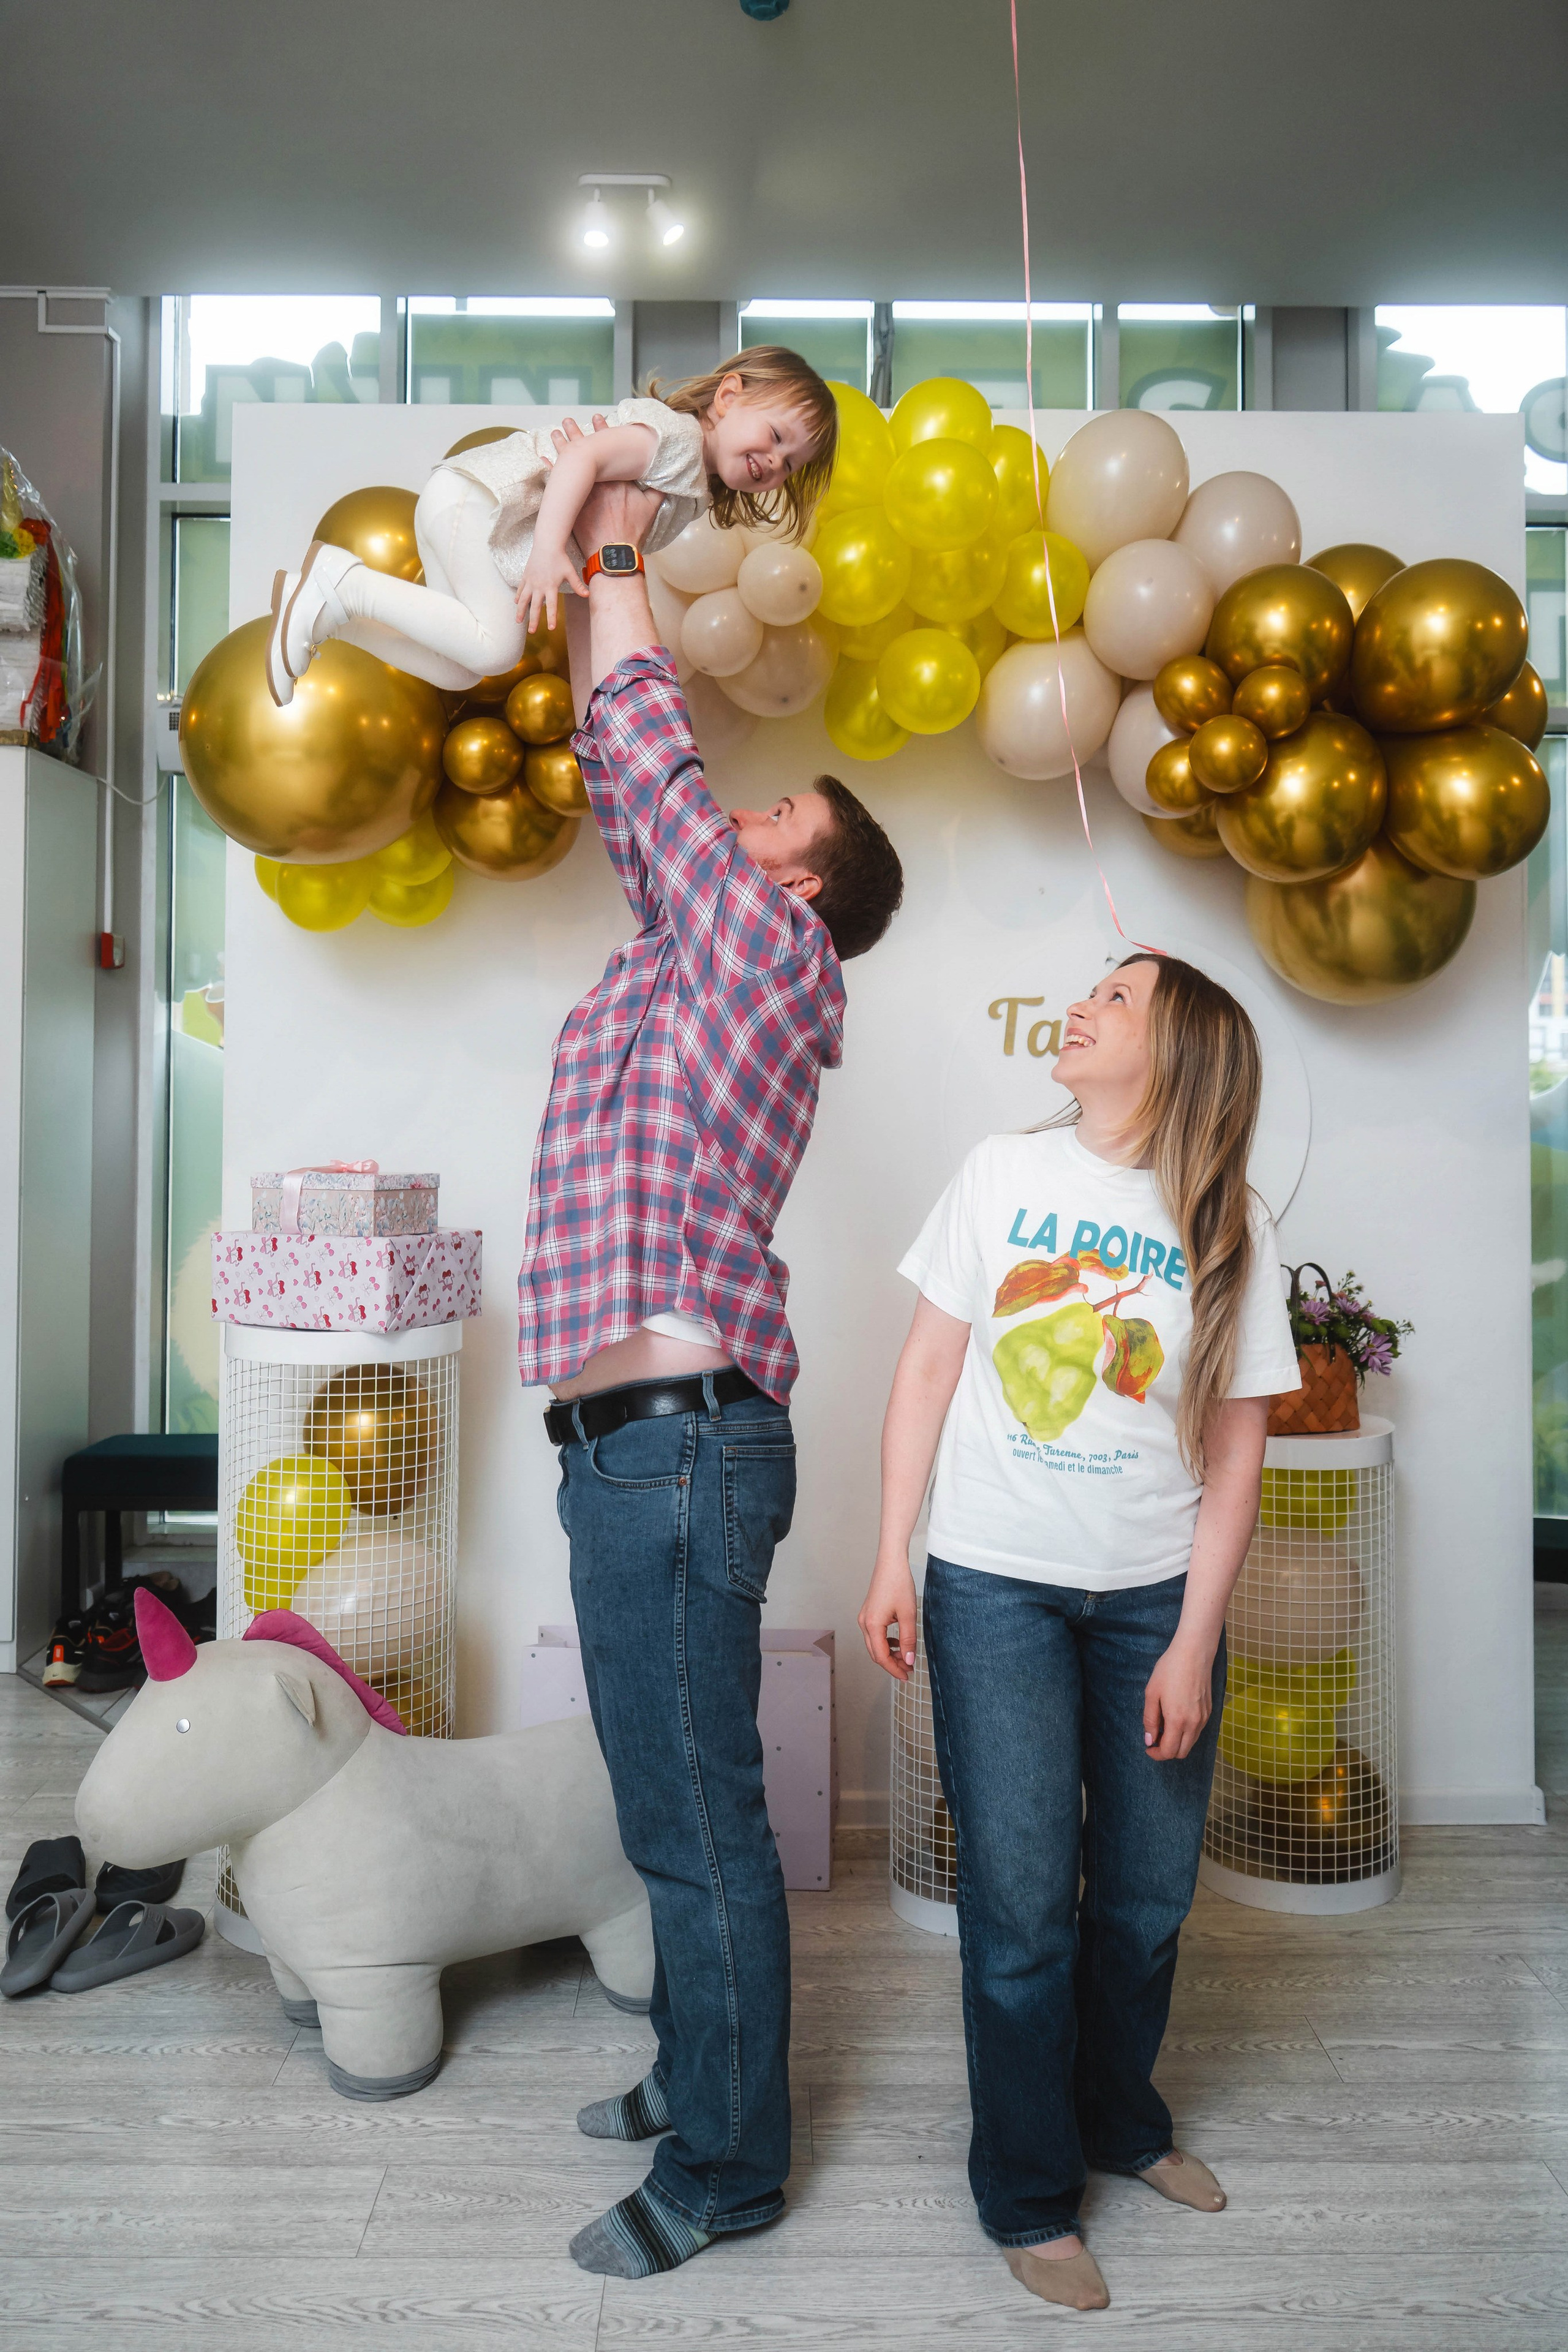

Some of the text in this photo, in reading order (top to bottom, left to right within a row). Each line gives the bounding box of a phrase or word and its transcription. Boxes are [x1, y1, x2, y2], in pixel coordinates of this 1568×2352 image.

[988, 996, 1062, 1058] Ta
[1007, 1208, 1187, 1291] LA POIRE
[1007, 1433, 1018, 1442] 116
[1042, 1444, 1085, 1461] Turenne,
[1089, 1453, 1111, 1463] 7003,
[1114, 1449, 1139, 1461] Paris
[1012, 1448, 1036, 1461] ouvert
[1044, 1460, 1065, 1471] amedi
[1068, 1462, 1076, 1472] et
[1078, 1462, 1085, 1473] le
[1087, 1464, 1123, 1474] dimanche
